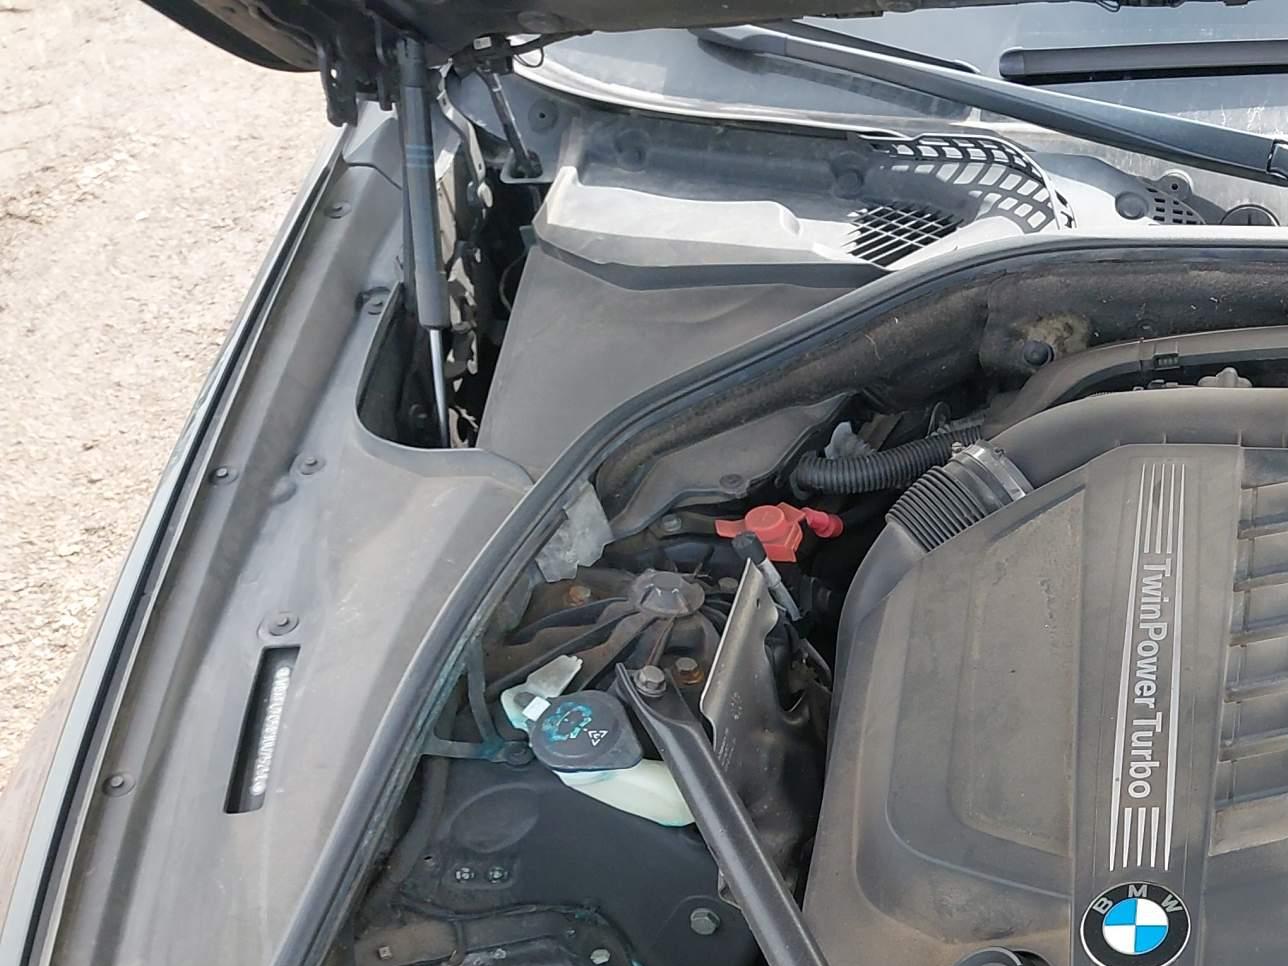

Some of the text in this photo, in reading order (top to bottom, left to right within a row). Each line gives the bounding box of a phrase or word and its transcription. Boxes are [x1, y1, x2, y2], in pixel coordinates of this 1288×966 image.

[1127, 558, 1171, 798] TwinPower Turbo
[1093, 884, 1182, 914] BMW
